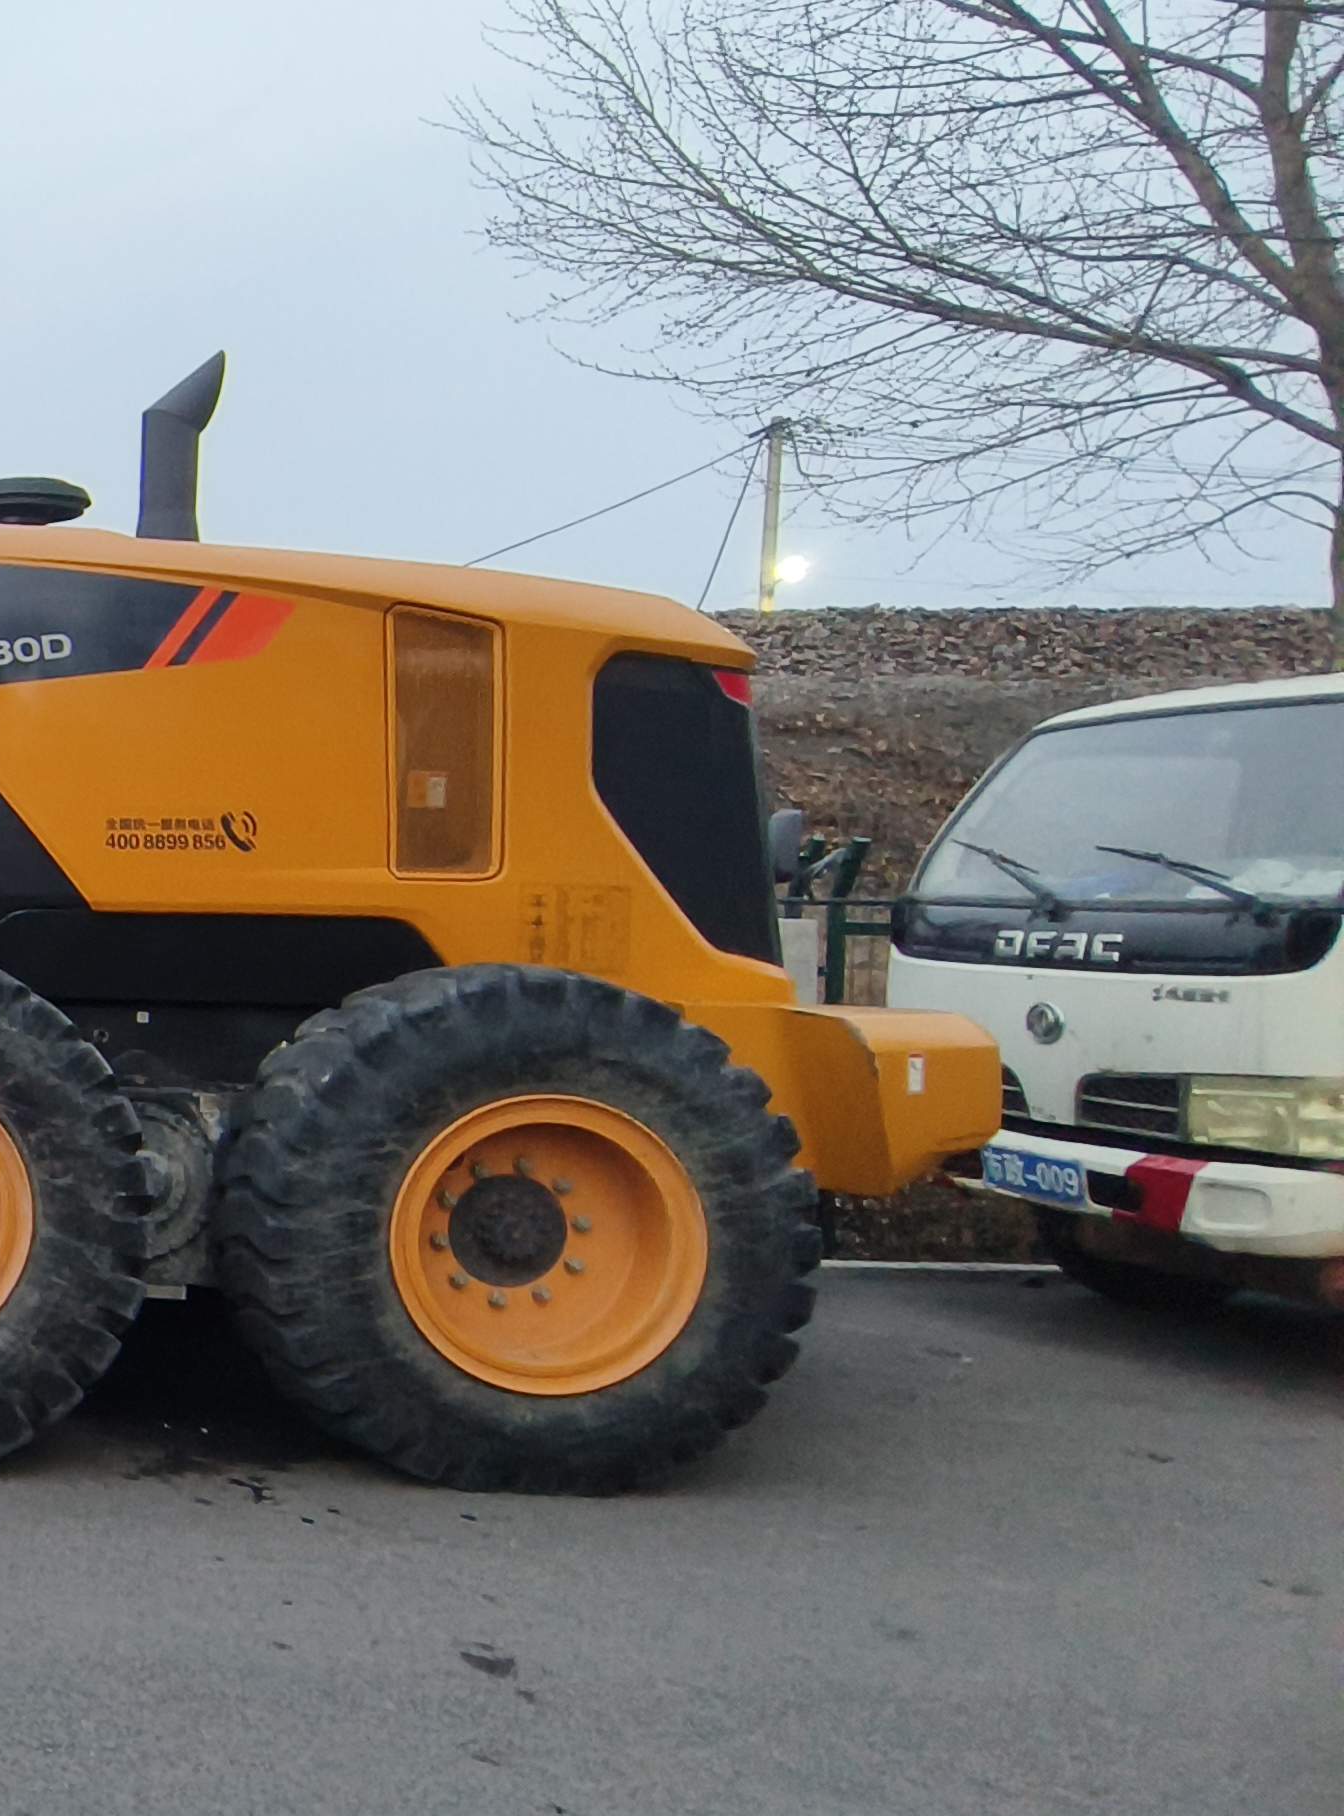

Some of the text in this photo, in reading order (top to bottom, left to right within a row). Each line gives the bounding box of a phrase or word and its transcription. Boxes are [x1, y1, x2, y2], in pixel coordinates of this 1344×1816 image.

[105, 833, 226, 850] 400 8899 856
[994, 929, 1124, 963] DFAC
